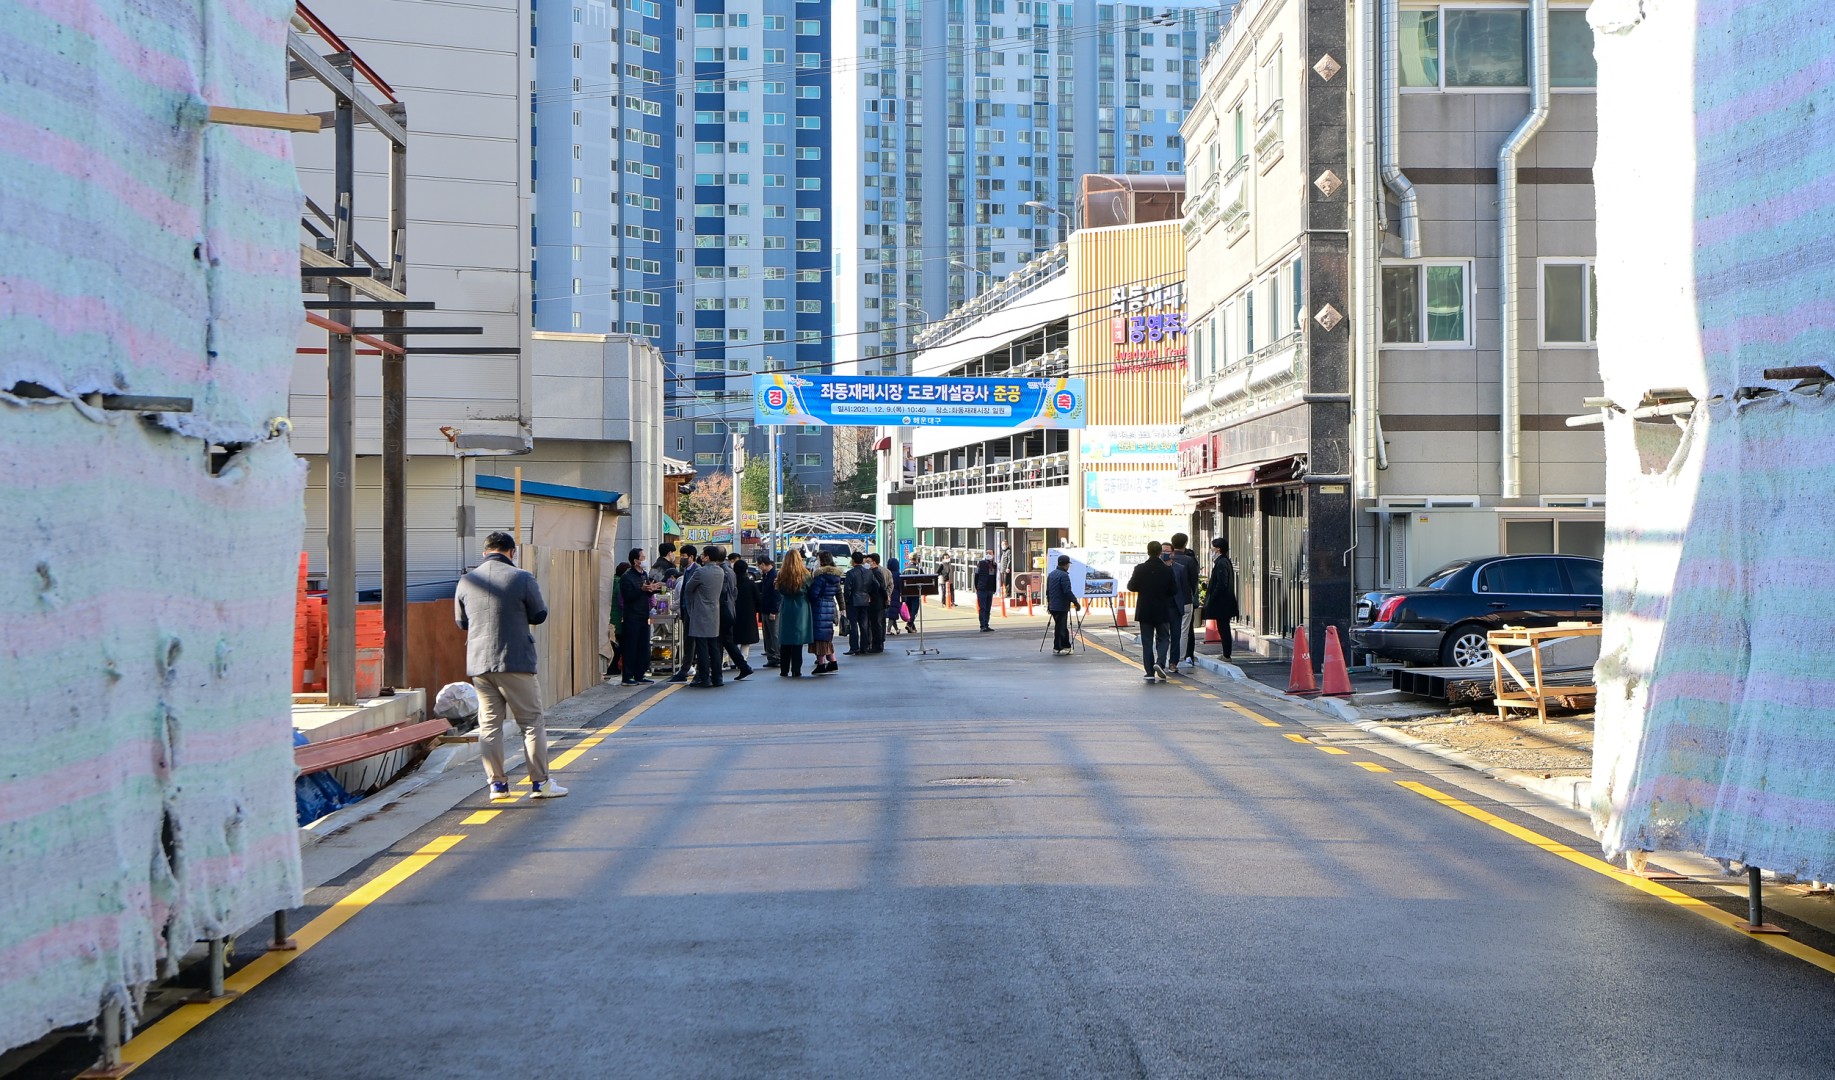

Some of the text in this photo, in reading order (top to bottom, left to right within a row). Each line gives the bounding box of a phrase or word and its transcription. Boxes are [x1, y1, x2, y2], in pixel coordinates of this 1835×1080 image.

[1114, 348, 1159, 361] Jwadong
[769, 389, 783, 407] 경
[820, 382, 904, 401] 좌동재래시장
[907, 384, 989, 402] 도로개설공사
[993, 385, 1021, 403] 준공
[1057, 393, 1072, 410] 축
[837, 405, 872, 413] 일시:2021.
[912, 416, 942, 425] 해운대구
[687, 528, 710, 542] 세차
